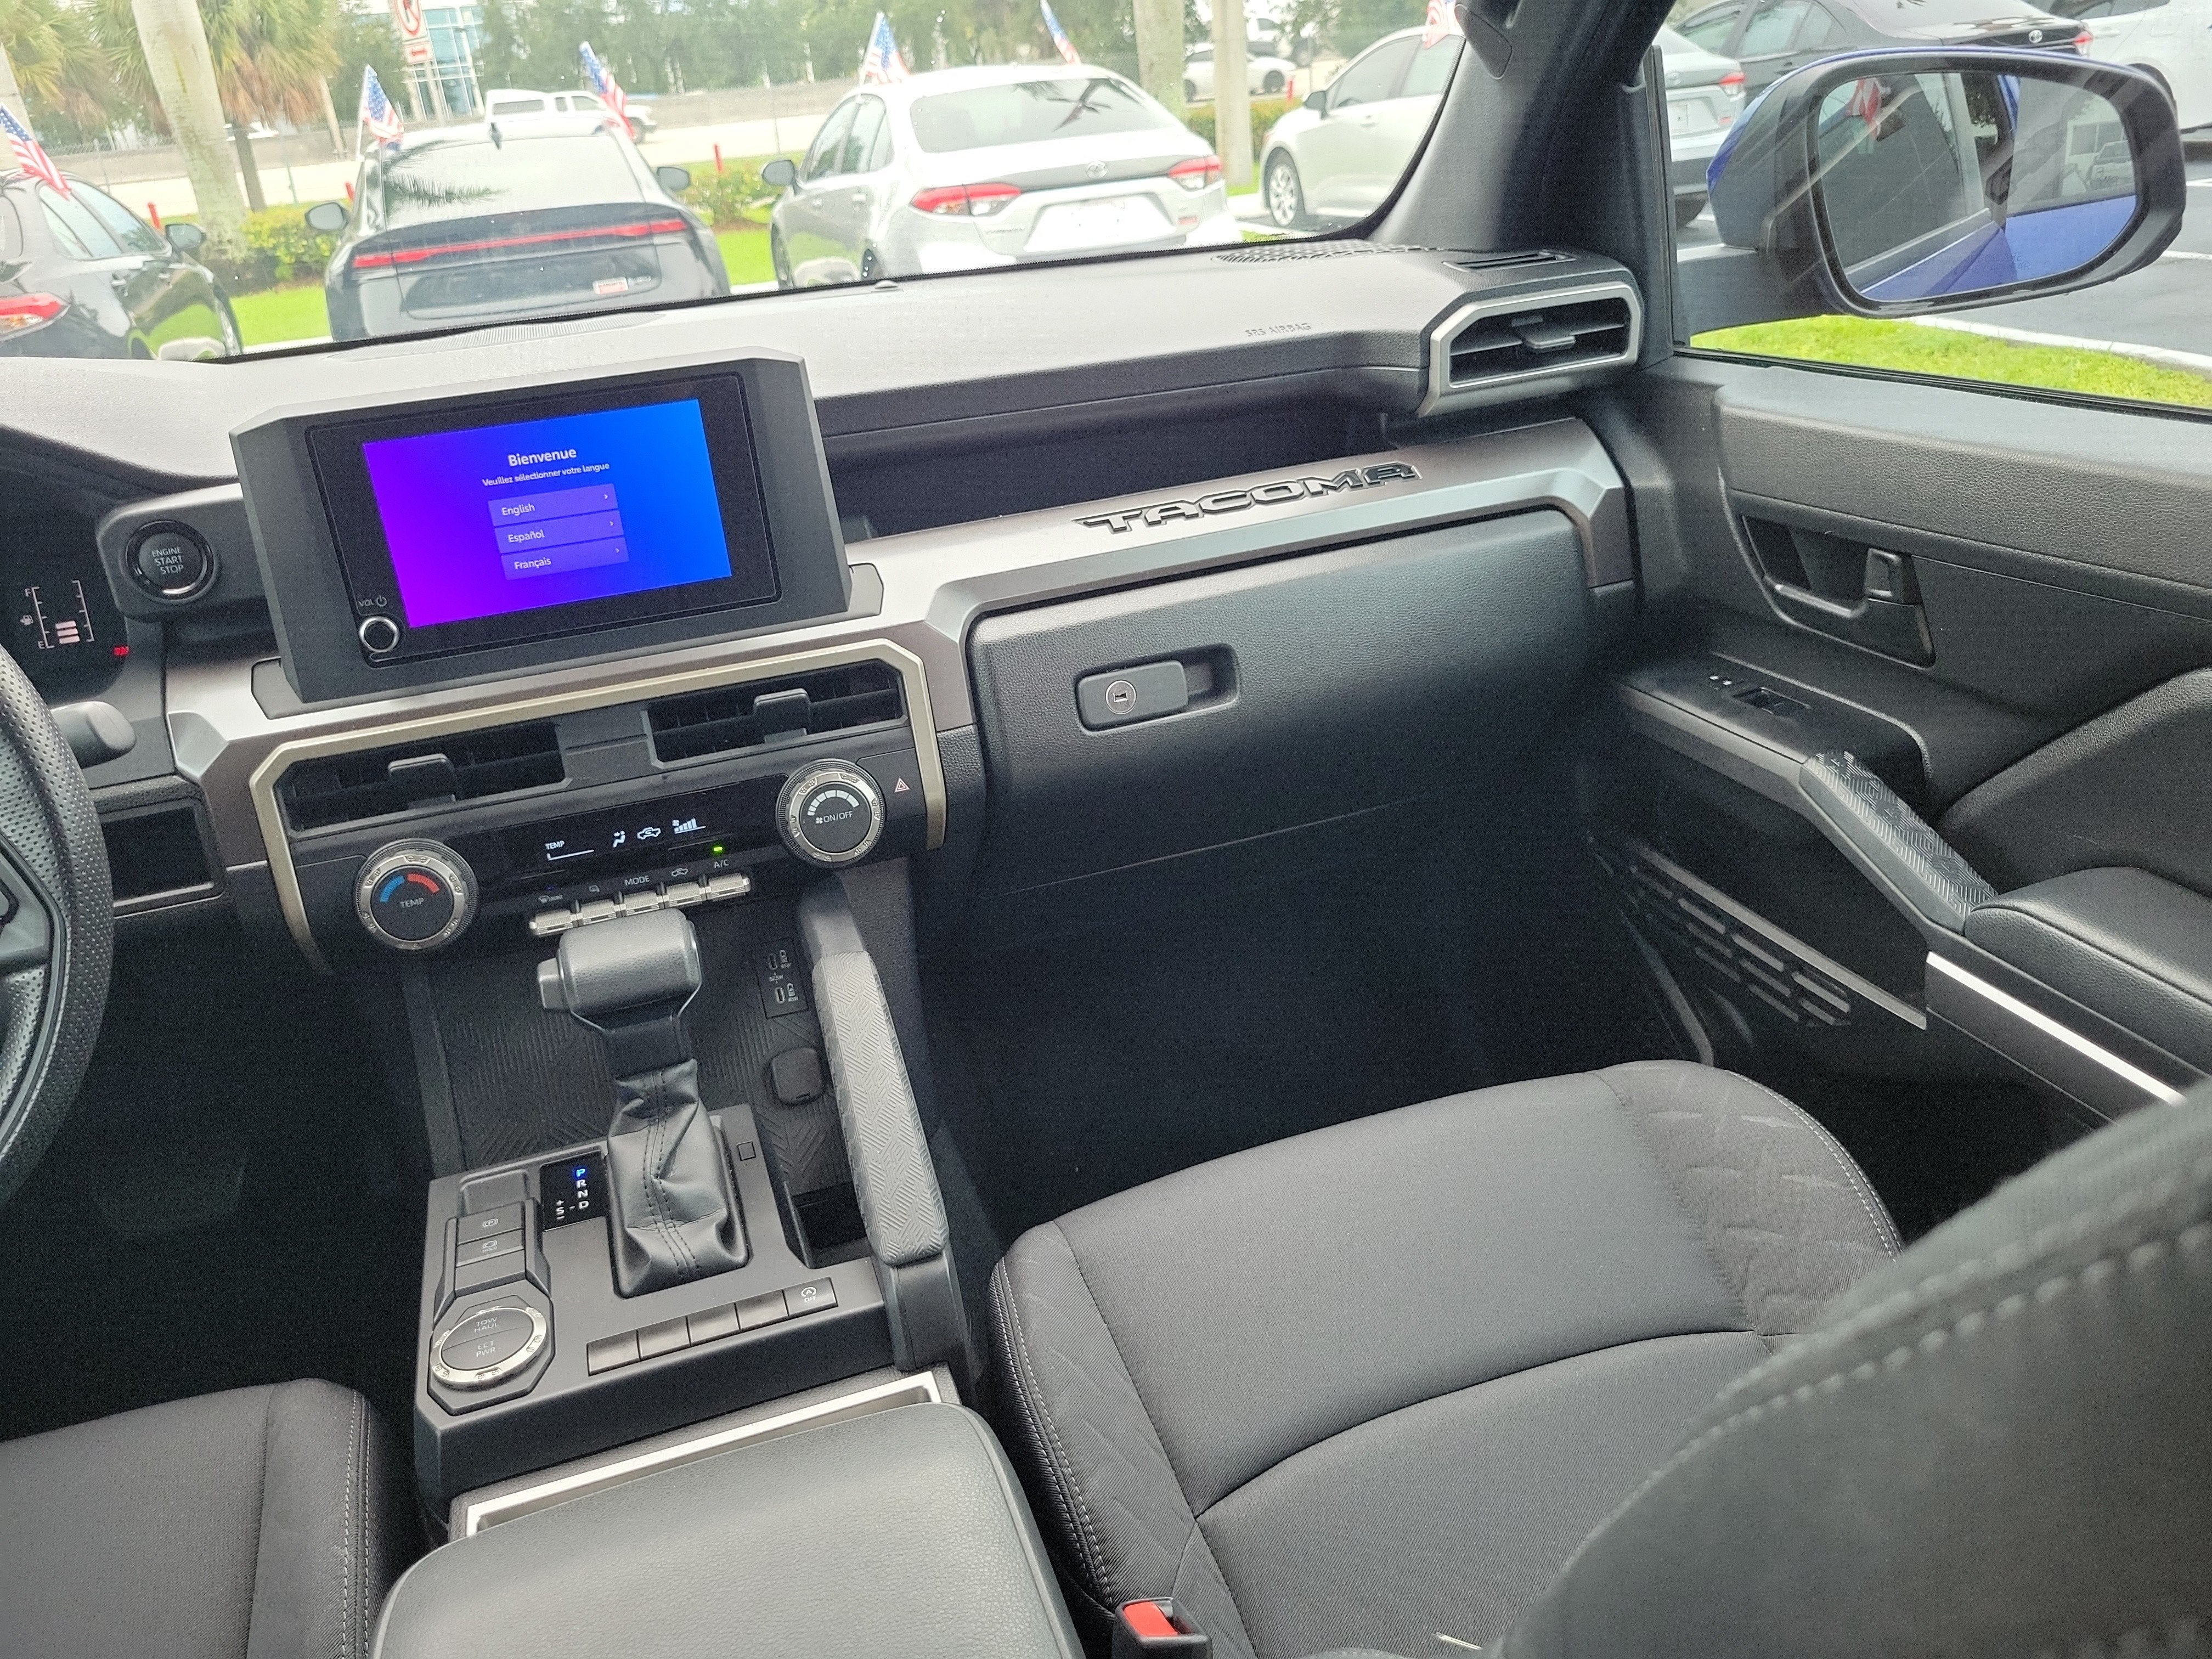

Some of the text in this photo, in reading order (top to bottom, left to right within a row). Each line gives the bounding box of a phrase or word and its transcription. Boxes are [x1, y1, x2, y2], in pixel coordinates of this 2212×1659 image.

[2003, 252, 2023, 261] ARE
[1990, 261, 2031, 272] APPEAR
[1245, 323, 1312, 337] SRS AIRBAG
[507, 448, 577, 467] Bienvenue
[482, 462, 610, 487] Veuillez sélectionner votre langue
[1072, 461, 1423, 534] TACOMA
[501, 503, 535, 517] English
[507, 529, 545, 544] Español
[152, 546, 182, 557] ENGINE
[154, 554, 183, 566] START
[514, 556, 552, 570] Français
[160, 564, 184, 574] STOP
[25, 588, 32, 597] F
[37, 640, 45, 649] E
[823, 810, 854, 823] ON/OFF
[545, 840, 565, 850] TEMP
[714, 859, 730, 868] A/C
[624, 876, 650, 886] MODE
[400, 898, 424, 908] TEMP
[576, 1168, 586, 1178] P
[576, 1179, 588, 1189] R
[577, 1189, 589, 1199] N
[578, 1200, 589, 1210] D
[476, 1317, 498, 1327] TOW
[474, 1323, 498, 1333] HAUL
[478, 1340, 493, 1350] ECT
[476, 1347, 496, 1357] PWR
